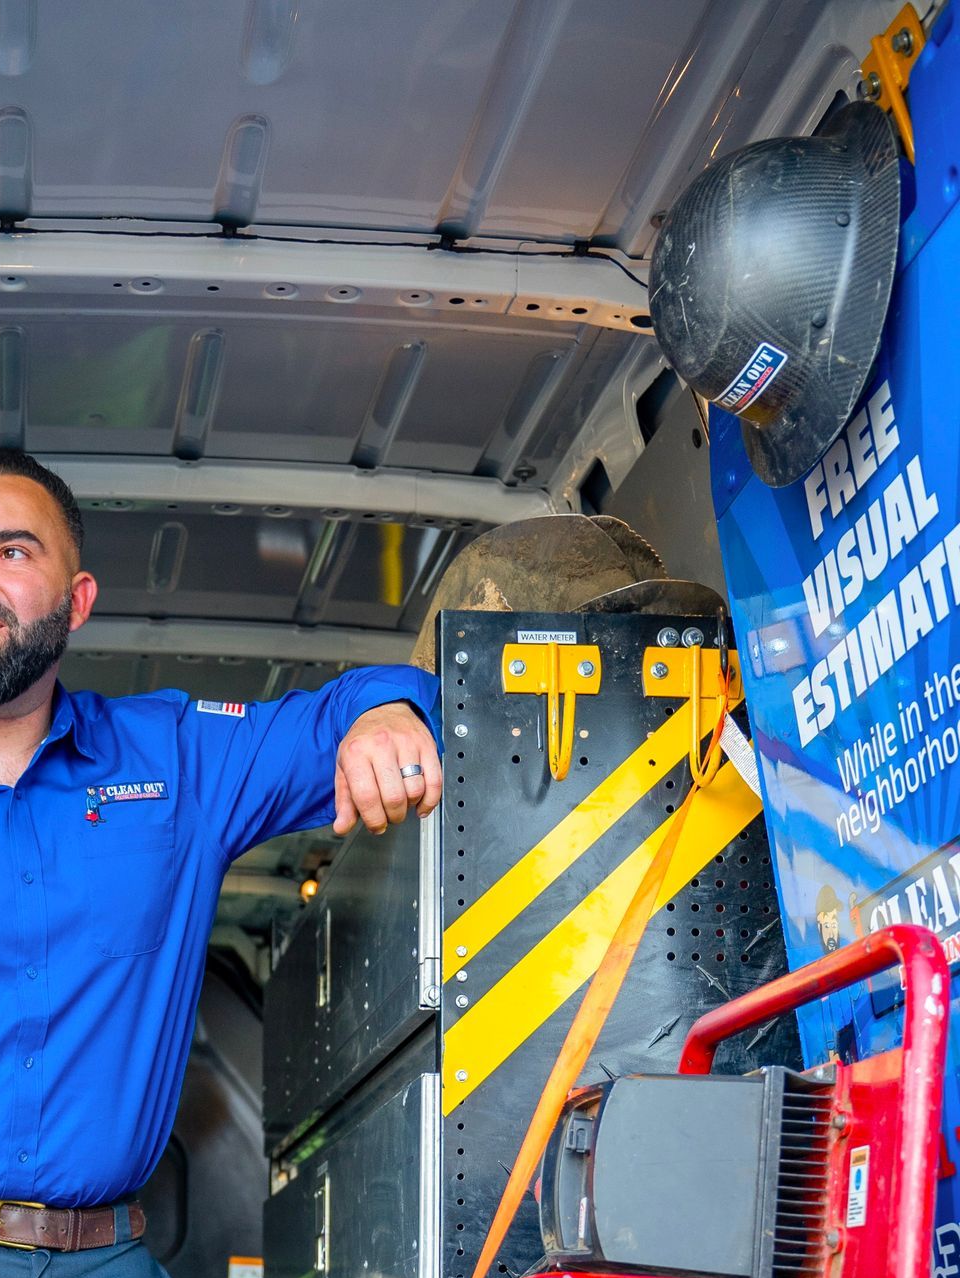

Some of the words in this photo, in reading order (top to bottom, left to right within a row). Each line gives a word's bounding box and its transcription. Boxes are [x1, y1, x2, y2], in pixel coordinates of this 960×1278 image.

[746, 350, 773, 381] OUT
[804, 379, 900, 541] FREE
[802, 454, 939, 639] VISUAL
[520, 632, 548, 642] WATER
[549, 633, 575, 642] METER
[106, 783, 141, 797] CLEAN
[143, 782, 165, 793] OUT
[836, 721, 898, 794] While
[898, 700, 924, 745] in
[836, 719, 960, 848] neighborho
